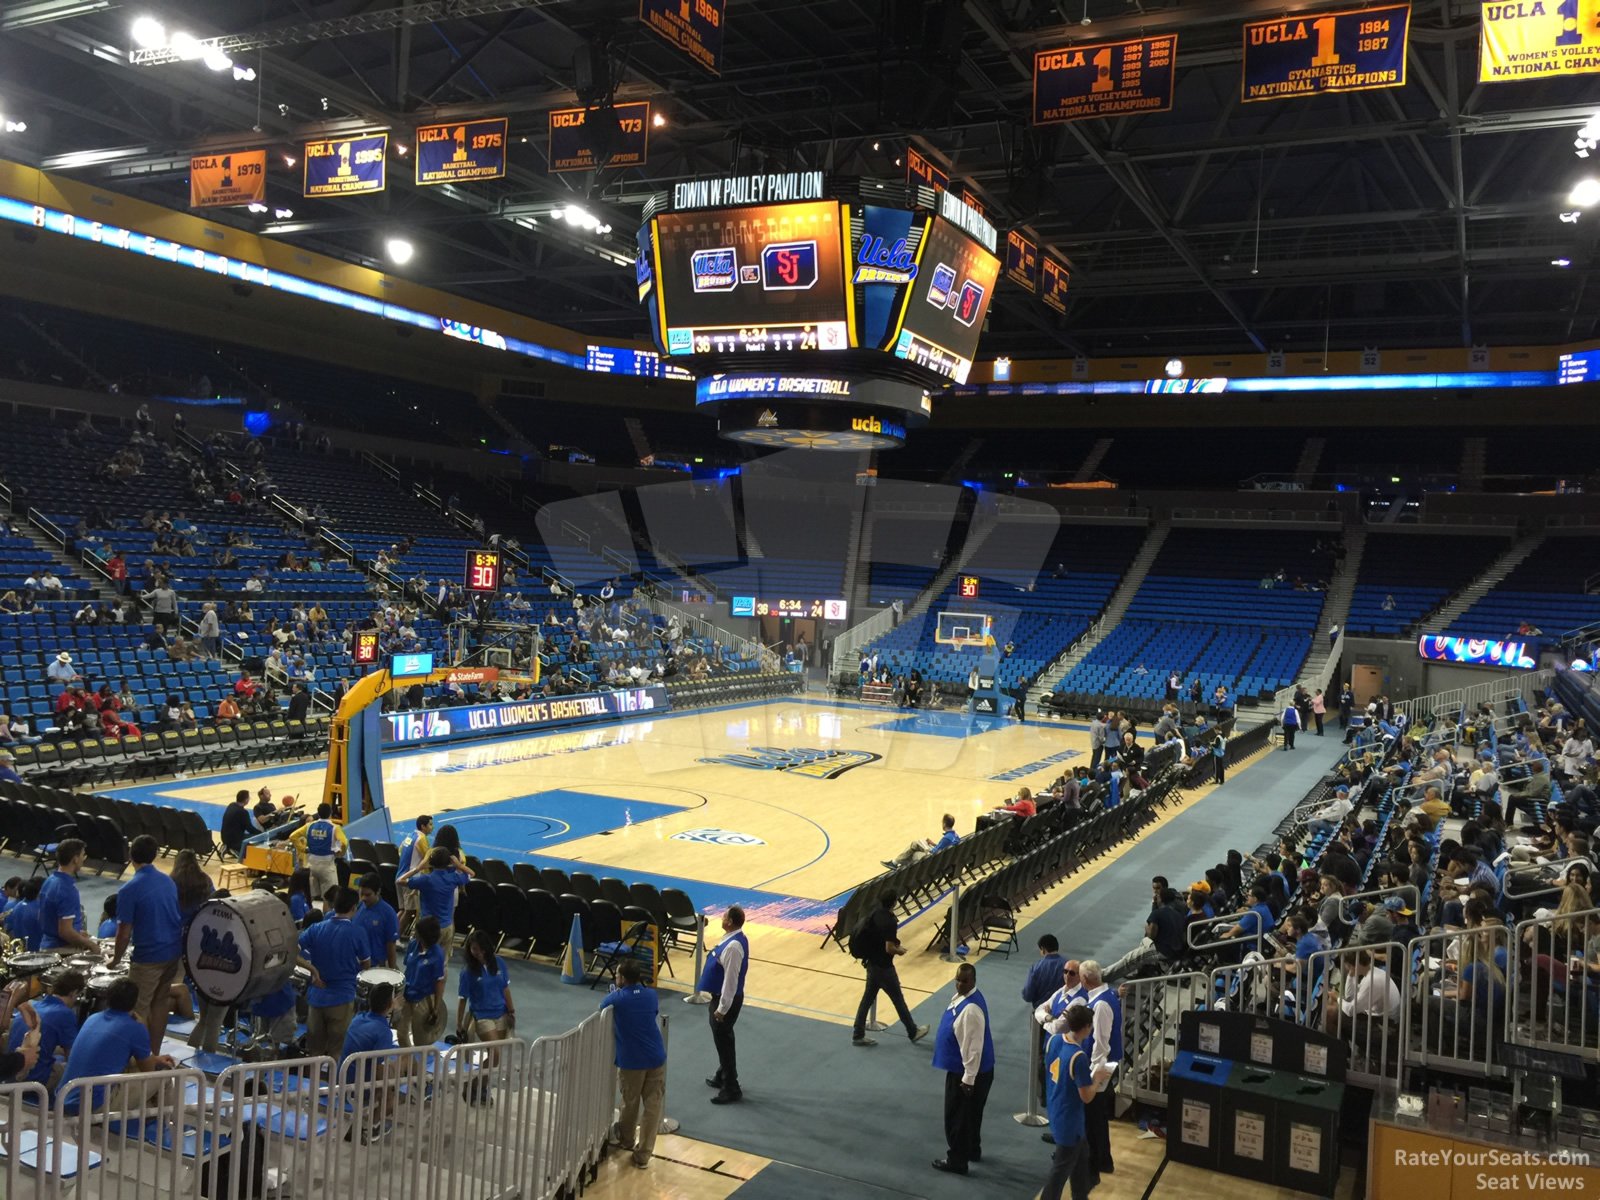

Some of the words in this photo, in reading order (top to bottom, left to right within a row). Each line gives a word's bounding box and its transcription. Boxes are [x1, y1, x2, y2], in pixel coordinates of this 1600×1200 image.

[695, 0, 719, 27] 1968
[1360, 20, 1390, 34] 1984
[1488, 2, 1546, 21] UCLA
[1556, 0, 1582, 46] 1
[1251, 22, 1308, 45] UCLA
[1312, 17, 1340, 66] 1
[1358, 37, 1389, 52] 1987
[1507, 49, 1558, 61] WOMEN'S
[1039, 51, 1086, 71] UCLA
[1092, 48, 1113, 92] 1
[1288, 64, 1356, 80] GYMNASTICS
[1493, 61, 1560, 75] NATIONAL
[1250, 80, 1314, 96] NATIONAL
[1320, 70, 1396, 87] CHAMPIONS
[1060, 95, 1086, 105] MEN'S
[1088, 89, 1143, 101] VOLLEYBALL
[1043, 105, 1096, 119] NATIONAL
[1099, 97, 1161, 111] CHAMPIONS
[553, 113, 586, 128] UCLA
[419, 128, 449, 142] UCLA
[453, 126, 467, 161] 1
[472, 134, 501, 149] 1975
[307, 144, 334, 157] UCLA
[338, 142, 352, 176] 1
[442, 161, 477, 169] BASKETBALL
[193, 159, 217, 169] UCLA
[221, 156, 232, 187] 1
[237, 164, 261, 177] 1978
[423, 170, 456, 180] NATIONAL
[457, 166, 497, 177] CHAMPIONS
[310, 183, 341, 192] NATIONAL
[674, 182, 709, 209] EDWIN
[710, 179, 722, 205] W
[723, 174, 766, 204] PAULEY
[767, 171, 823, 200] PAVILION
[696, 335, 710, 353] 36
[739, 328, 768, 343] 6:34
[800, 332, 816, 350] 24
[728, 378, 775, 393] WOMEN'S
[777, 377, 850, 395] BASKETBALL
[476, 555, 496, 566] 6:34
[473, 567, 492, 587] 30
[962, 585, 974, 596] 30
[779, 600, 801, 610] 6:34
[811, 606, 822, 617] 24
[359, 647, 372, 659] 30
[469, 710, 498, 730] UCLA
[499, 702, 549, 726] WOMEN'S
[550, 696, 609, 720] BASKETBALL
